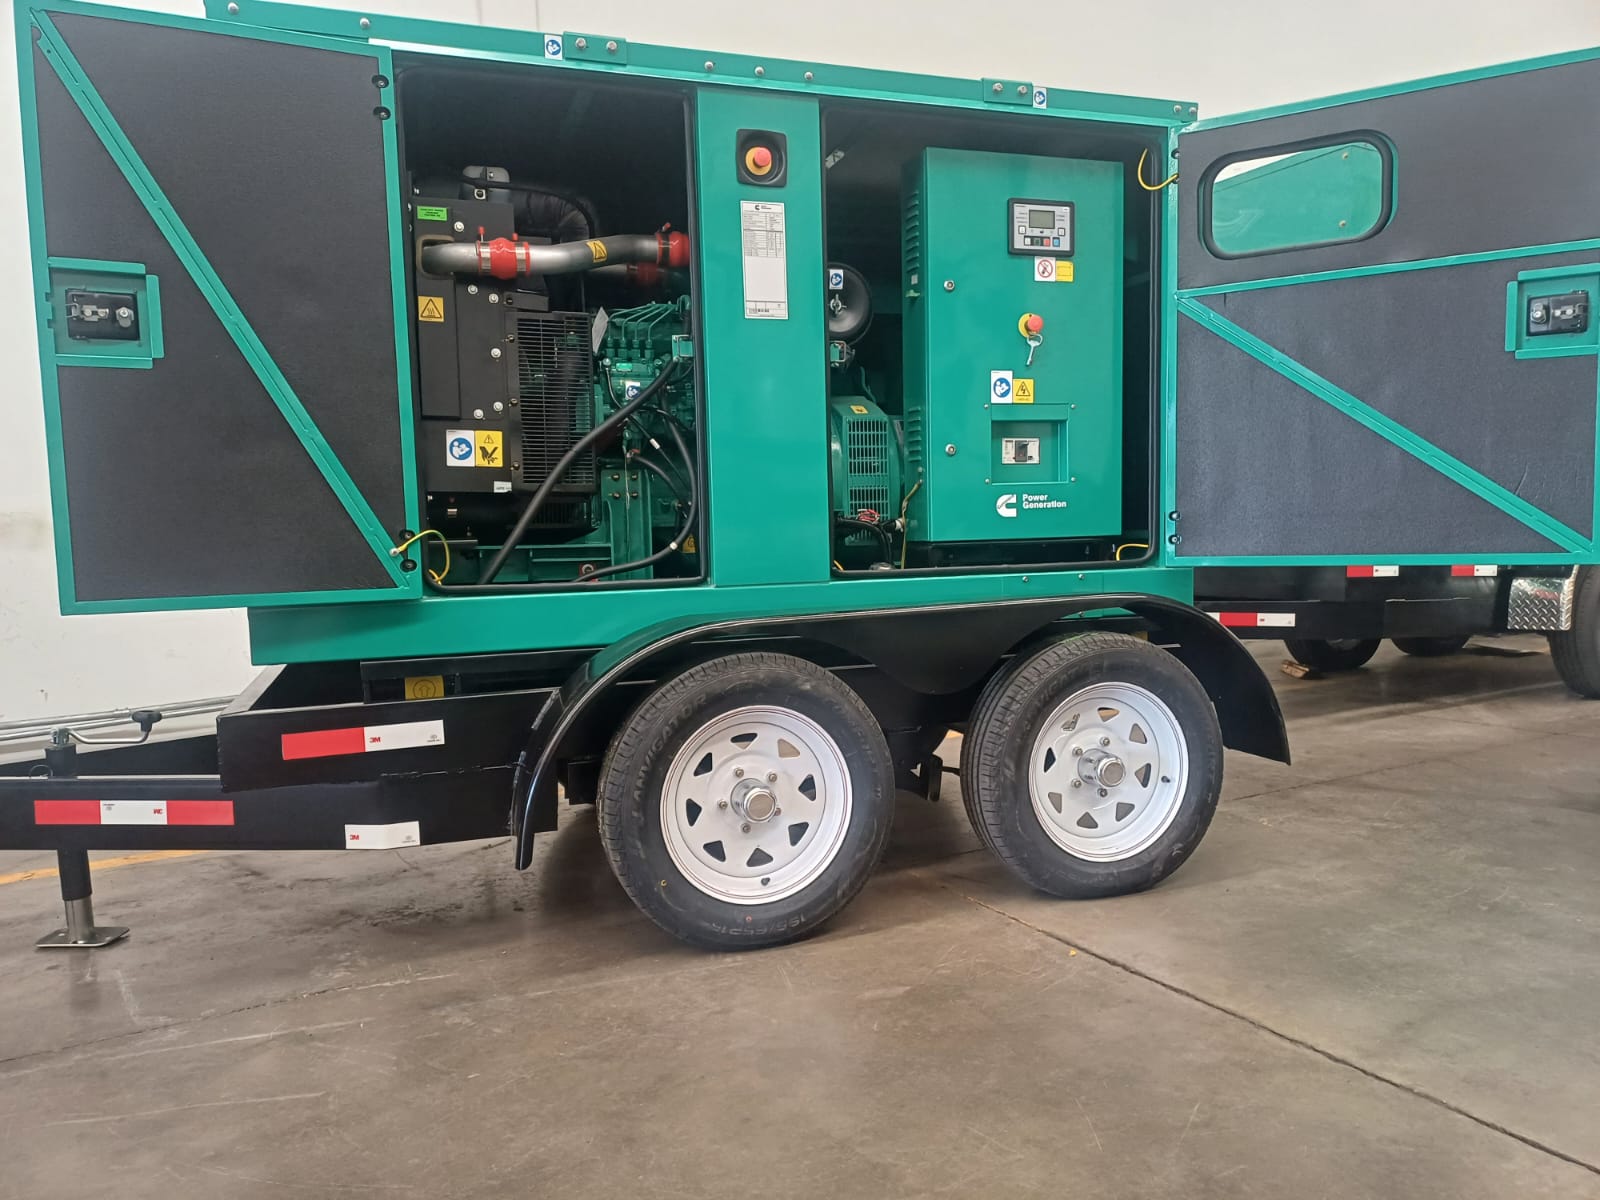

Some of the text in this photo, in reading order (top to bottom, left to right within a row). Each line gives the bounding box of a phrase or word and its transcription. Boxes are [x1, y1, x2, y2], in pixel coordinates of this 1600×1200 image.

[1022, 493, 1048, 501] Power
[1022, 500, 1067, 509] Generation
[631, 692, 708, 821] LANVIGATOR
